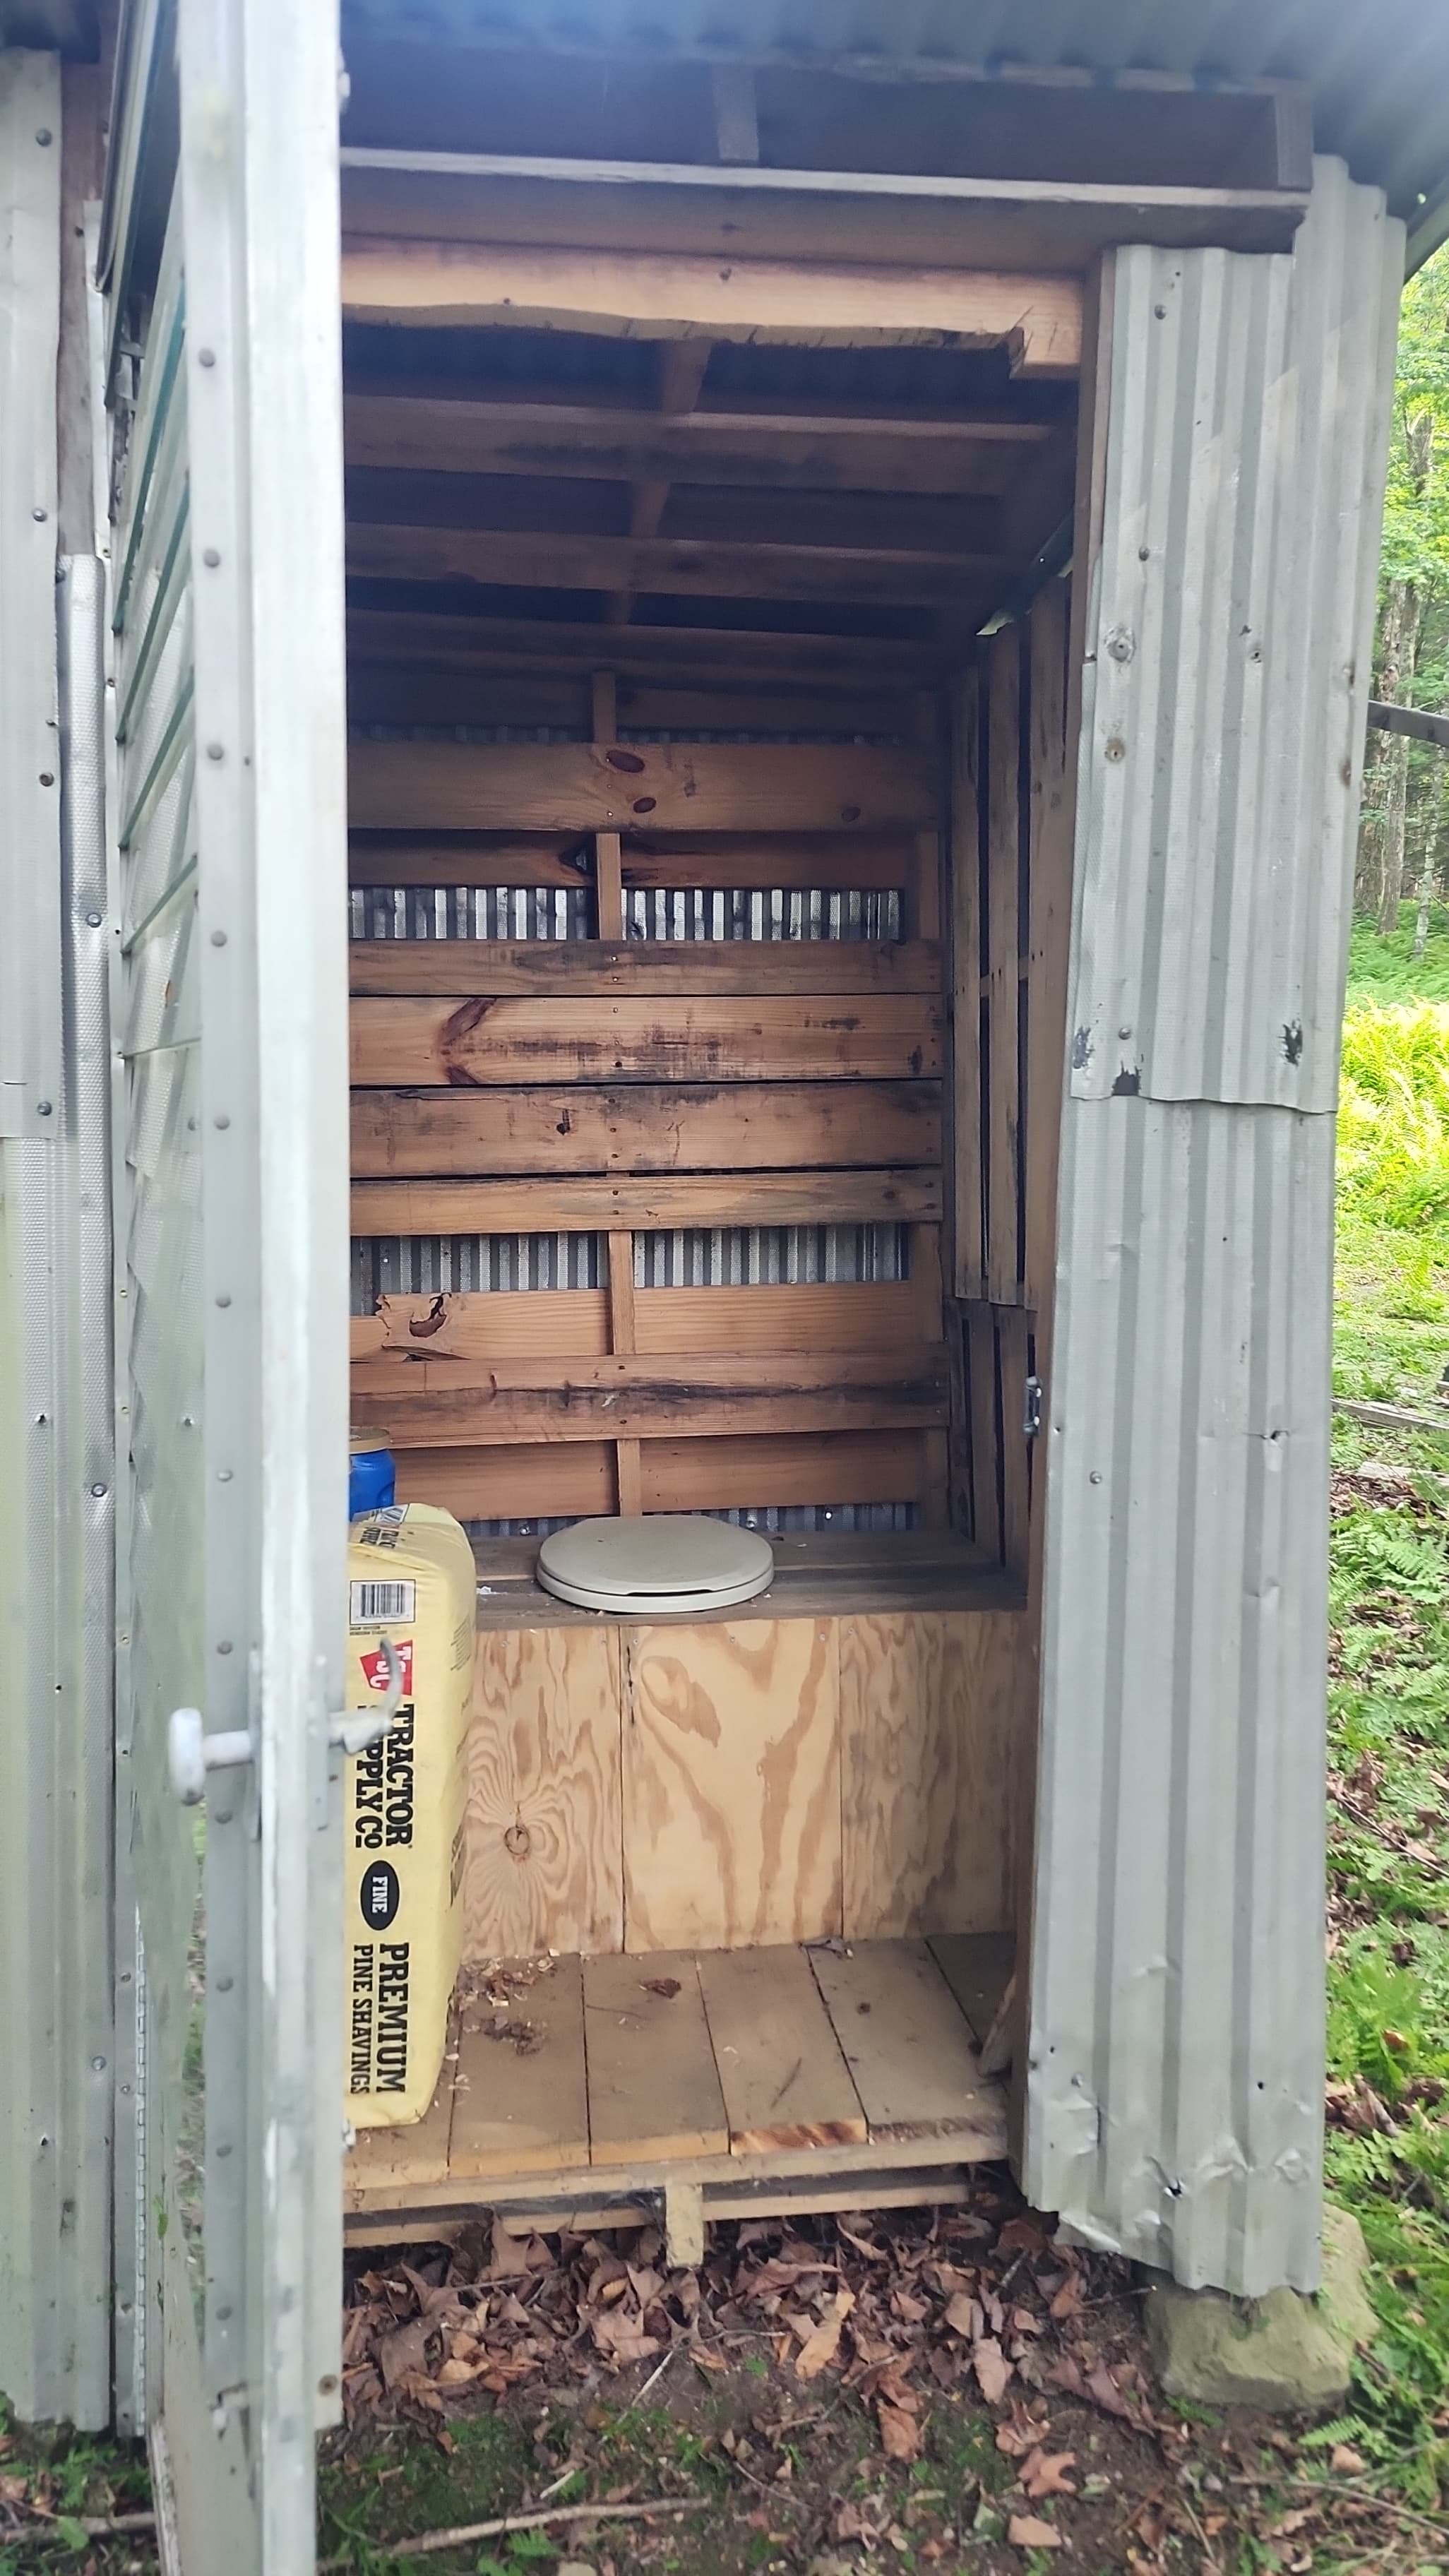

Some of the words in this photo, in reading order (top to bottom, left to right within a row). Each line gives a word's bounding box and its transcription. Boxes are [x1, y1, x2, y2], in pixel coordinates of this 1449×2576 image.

[386, 1704, 414, 1847] TRACTOR
[371, 1876, 388, 1913] FINE
[353, 1945, 373, 1992] PINE
[350, 1998, 371, 2094] SHAVINGS
[376, 1943, 409, 2093] PREMIUM
